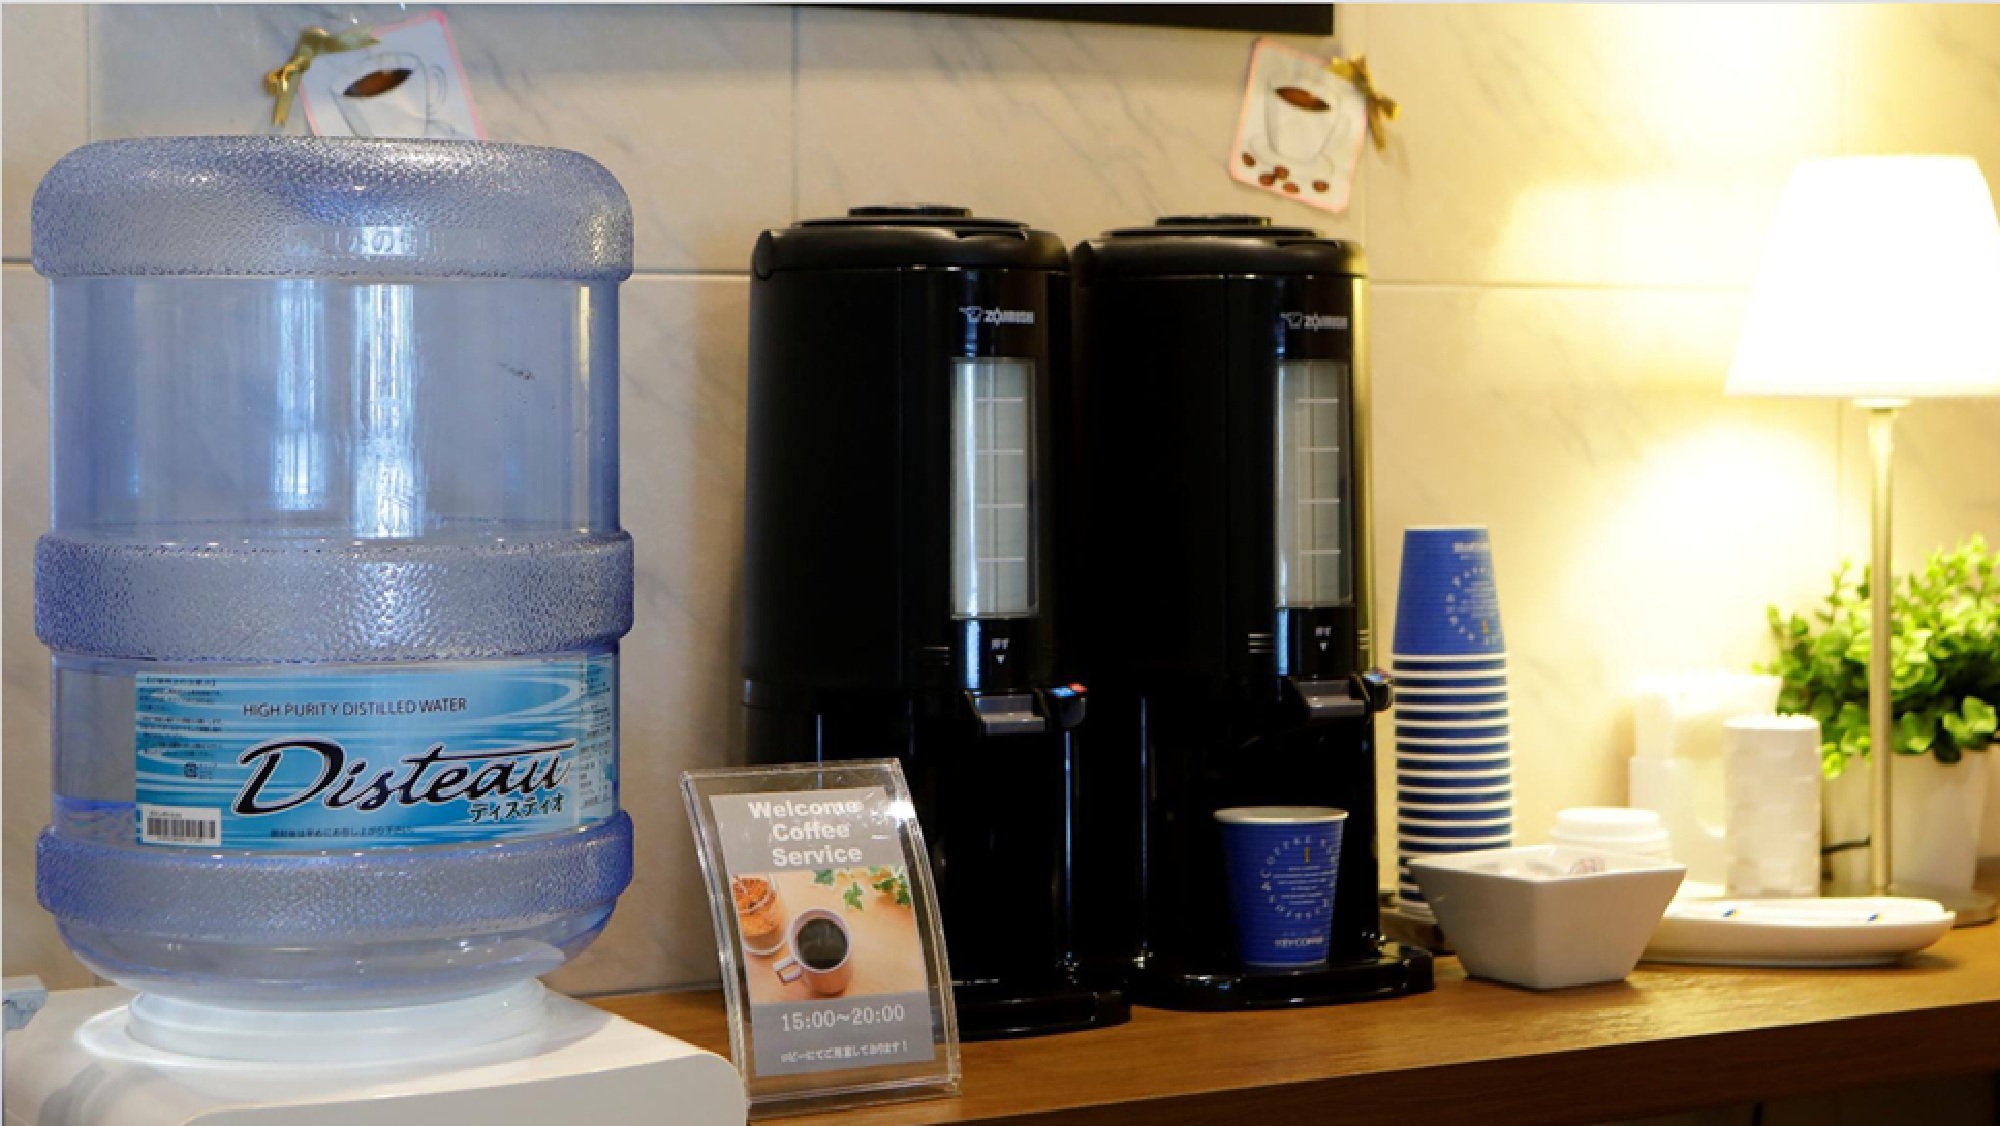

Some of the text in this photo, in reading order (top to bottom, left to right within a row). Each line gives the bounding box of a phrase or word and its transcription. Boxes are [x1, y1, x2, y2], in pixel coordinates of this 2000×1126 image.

[243, 697, 468, 717] HIGH PURITY DISTILLED WATER
[232, 738, 577, 815] Disteau
[470, 792, 565, 823] ディスティオ
[747, 800, 865, 819] Welcome
[771, 821, 851, 842] Coffee
[771, 844, 863, 867] Service
